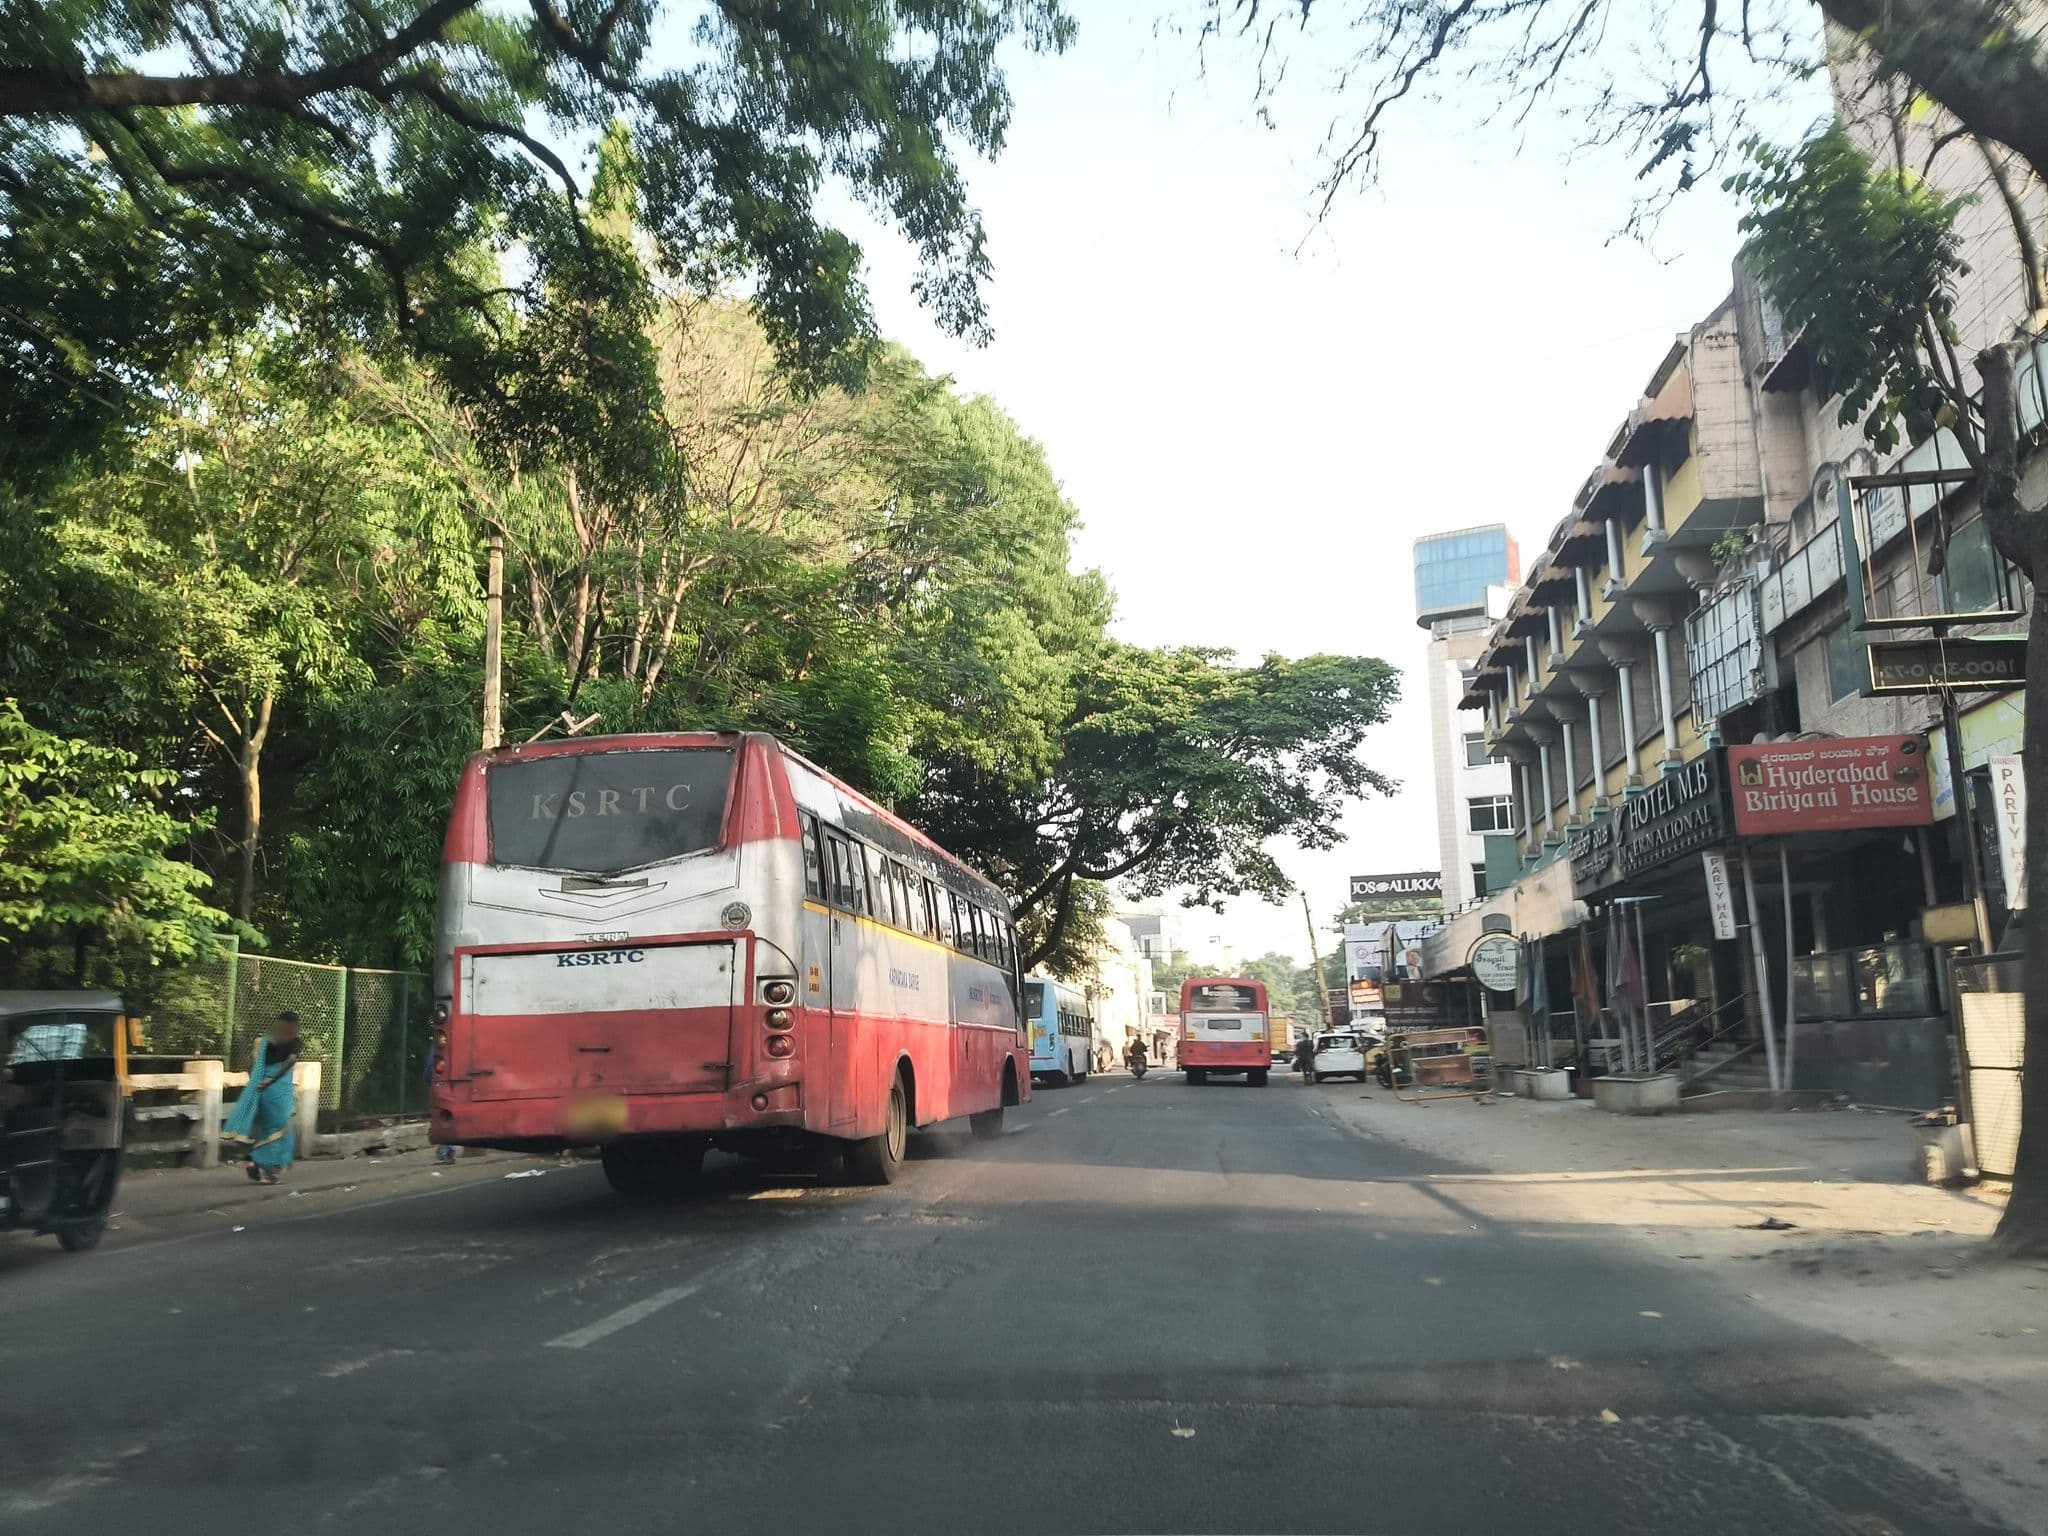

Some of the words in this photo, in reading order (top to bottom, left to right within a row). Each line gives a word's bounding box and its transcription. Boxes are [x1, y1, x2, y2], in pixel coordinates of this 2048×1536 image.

[1767, 761, 1889, 789] Hyderabad
[530, 784, 691, 820] KSRTC
[1628, 780, 1674, 831] HOTEL
[1678, 759, 1708, 804] M.B
[1744, 788, 1838, 813] Biriyani
[1850, 784, 1918, 806] House
[2001, 768, 2020, 839] PARTY
[1352, 881, 1376, 895] JOS
[1388, 878, 1442, 893] ALUKKA
[1710, 858, 1725, 900] PARTY
[1716, 903, 1729, 937] HALL
[557, 950, 644, 968] KSRTC
